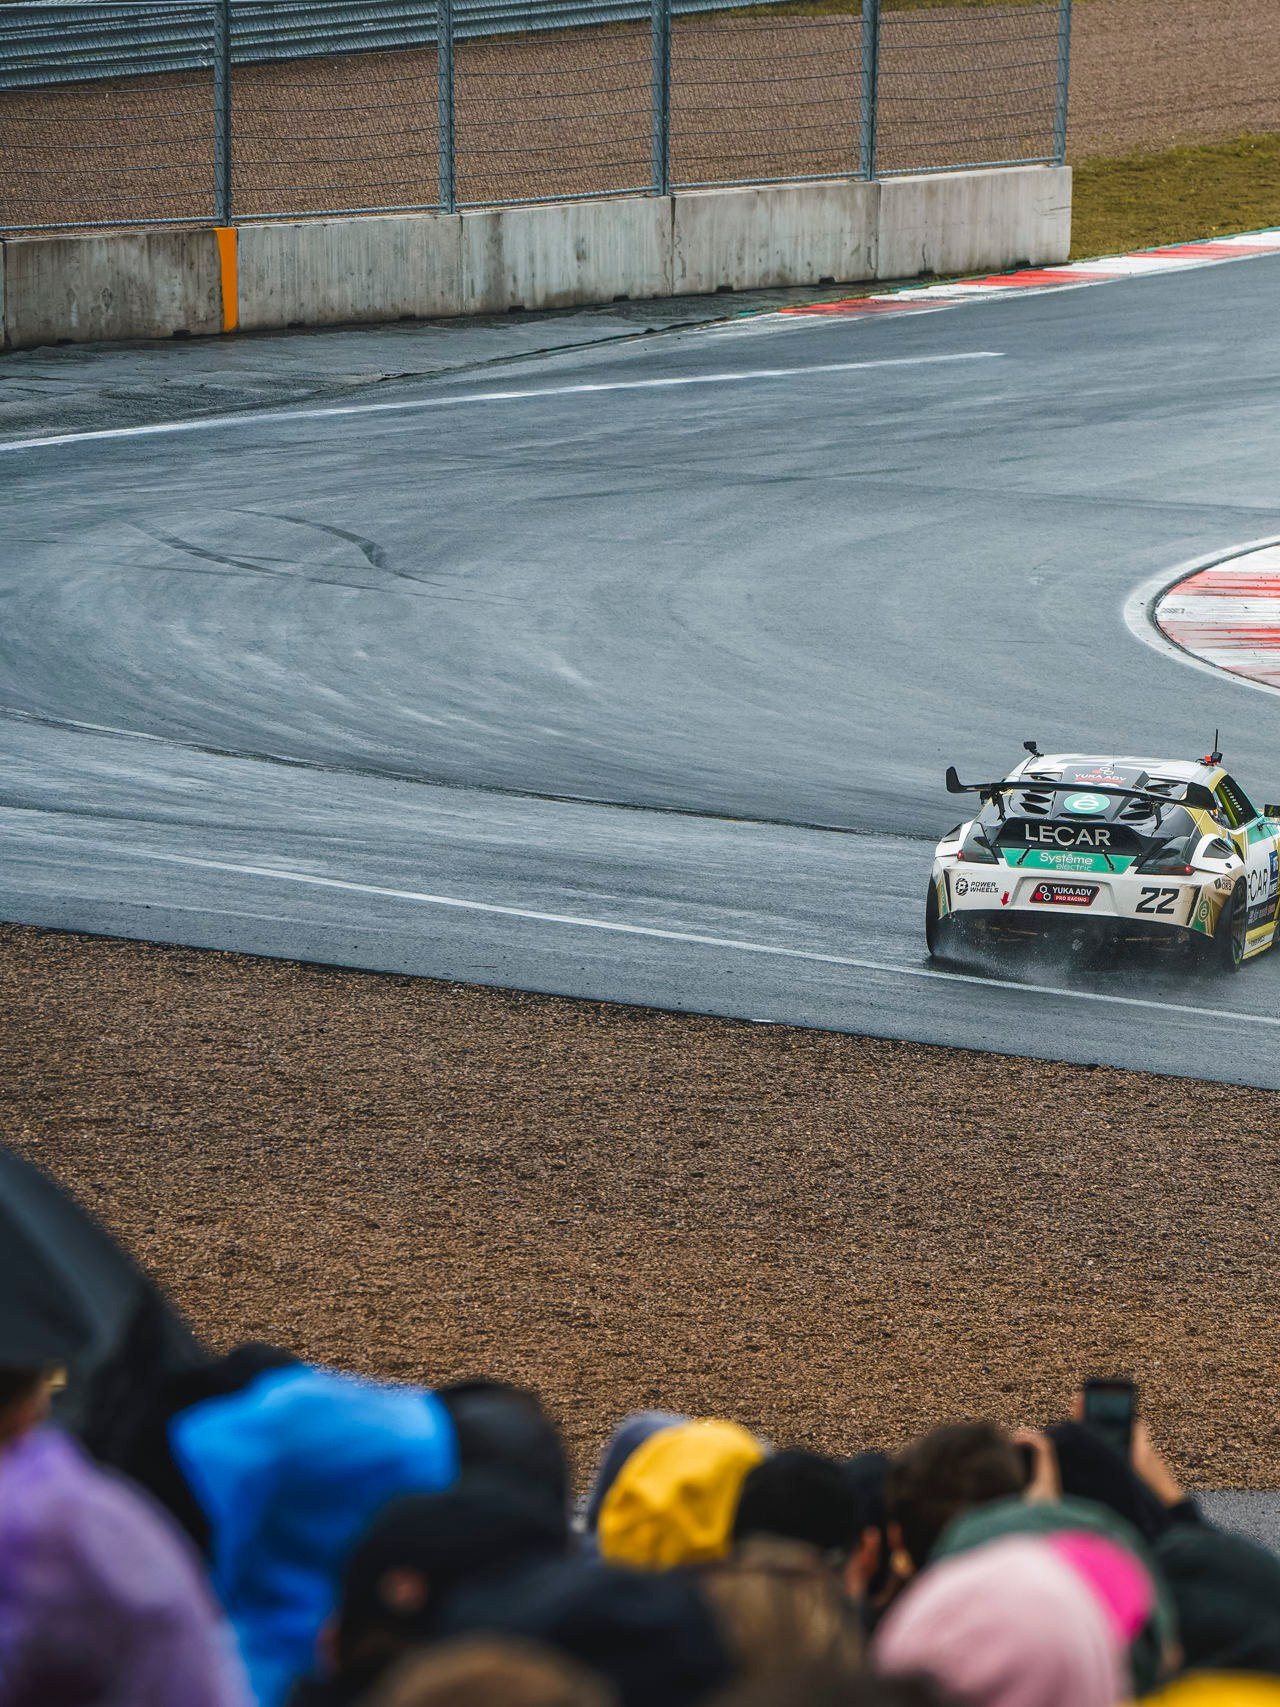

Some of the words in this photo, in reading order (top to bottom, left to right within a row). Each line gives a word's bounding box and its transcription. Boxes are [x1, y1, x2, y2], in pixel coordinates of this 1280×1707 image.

[1025, 823, 1111, 846] LECAR
[1056, 863, 1093, 872] electric
[1052, 886, 1074, 896] YUKA
[1076, 888, 1092, 897] ADV
[1135, 887, 1180, 914] 22
